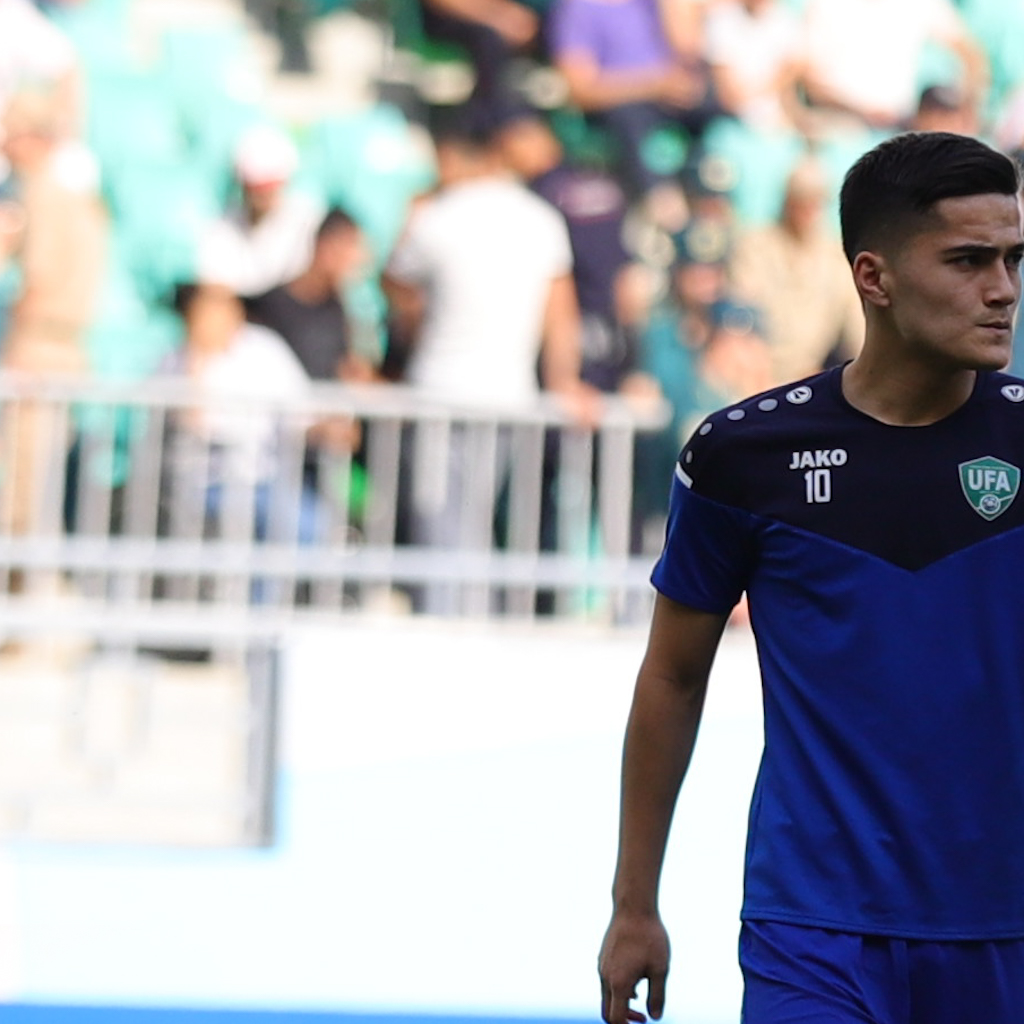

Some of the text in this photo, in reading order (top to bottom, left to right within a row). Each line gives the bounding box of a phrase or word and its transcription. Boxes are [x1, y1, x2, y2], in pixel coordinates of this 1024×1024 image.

[789, 448, 848, 470] JAKO
[804, 468, 831, 504] 10
[968, 469, 1011, 492] UFA
